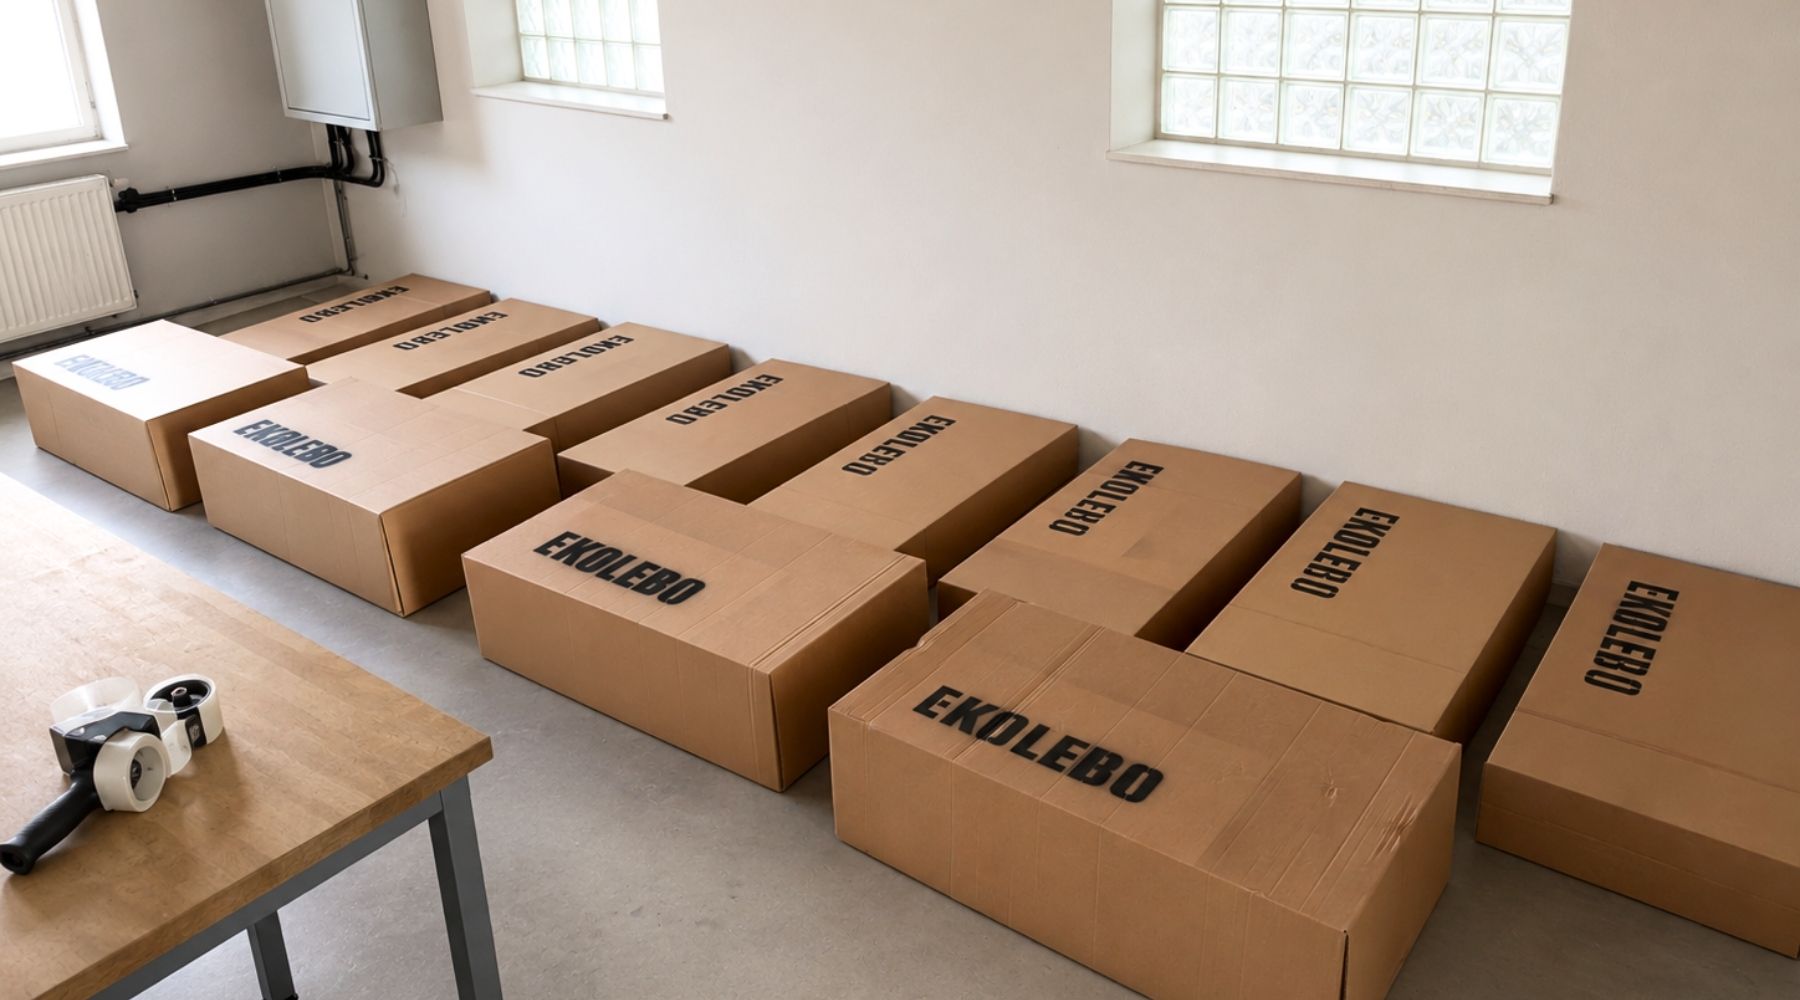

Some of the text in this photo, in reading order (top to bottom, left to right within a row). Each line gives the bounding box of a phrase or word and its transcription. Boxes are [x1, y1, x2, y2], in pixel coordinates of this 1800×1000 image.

[665, 373, 784, 425] EKOLEBO
[233, 419, 353, 468] EKOLEBO
[841, 414, 956, 476] EKOLEBO
[1049, 460, 1165, 537] EKOLEBO
[533, 531, 706, 606] EKOLEBO
[1290, 507, 1400, 599] EKOLEBO
[1584, 580, 1680, 696] EKOLEBO
[912, 685, 1165, 804] EKOLEBO
